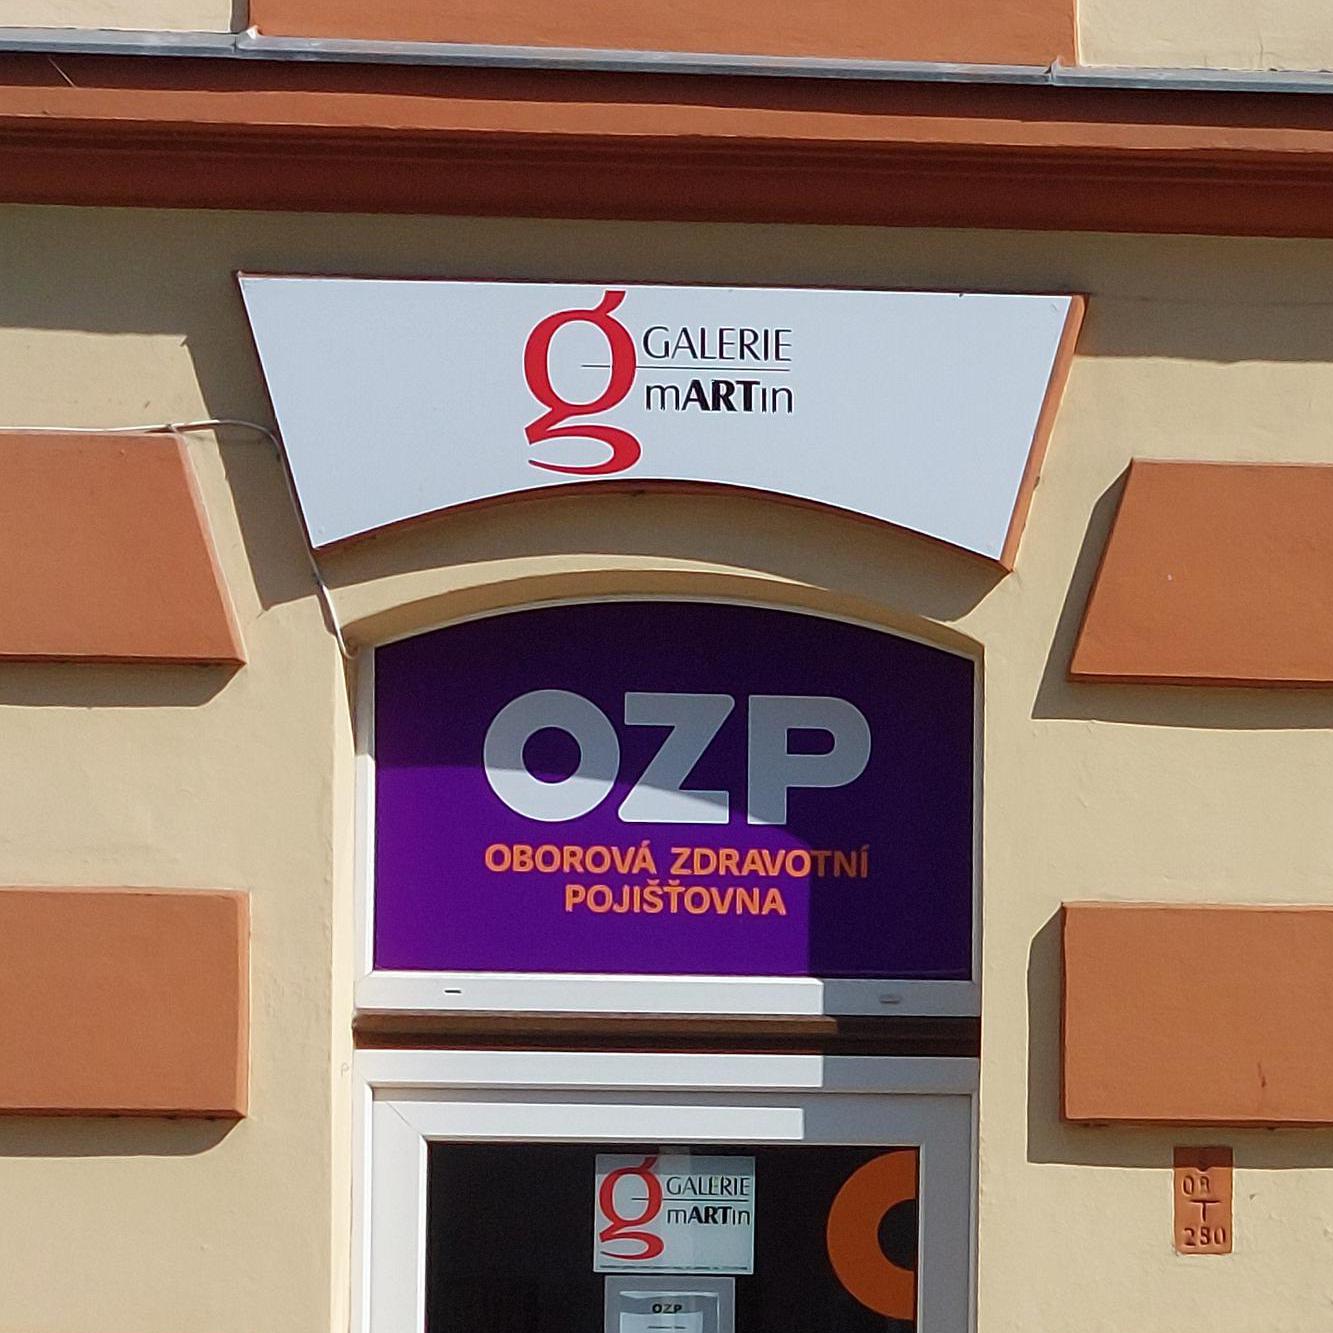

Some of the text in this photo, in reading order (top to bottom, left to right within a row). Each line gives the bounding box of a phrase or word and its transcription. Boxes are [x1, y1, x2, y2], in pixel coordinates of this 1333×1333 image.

[642, 326, 792, 361] GALERIE
[483, 689, 871, 825] OZP
[484, 840, 869, 878] OBOROVÁ ZDRAVOTNÍ
[565, 878, 786, 915] POJIŠŤOVNA
[666, 1176, 750, 1196] GALERIE
[652, 1303, 682, 1314] OZP
